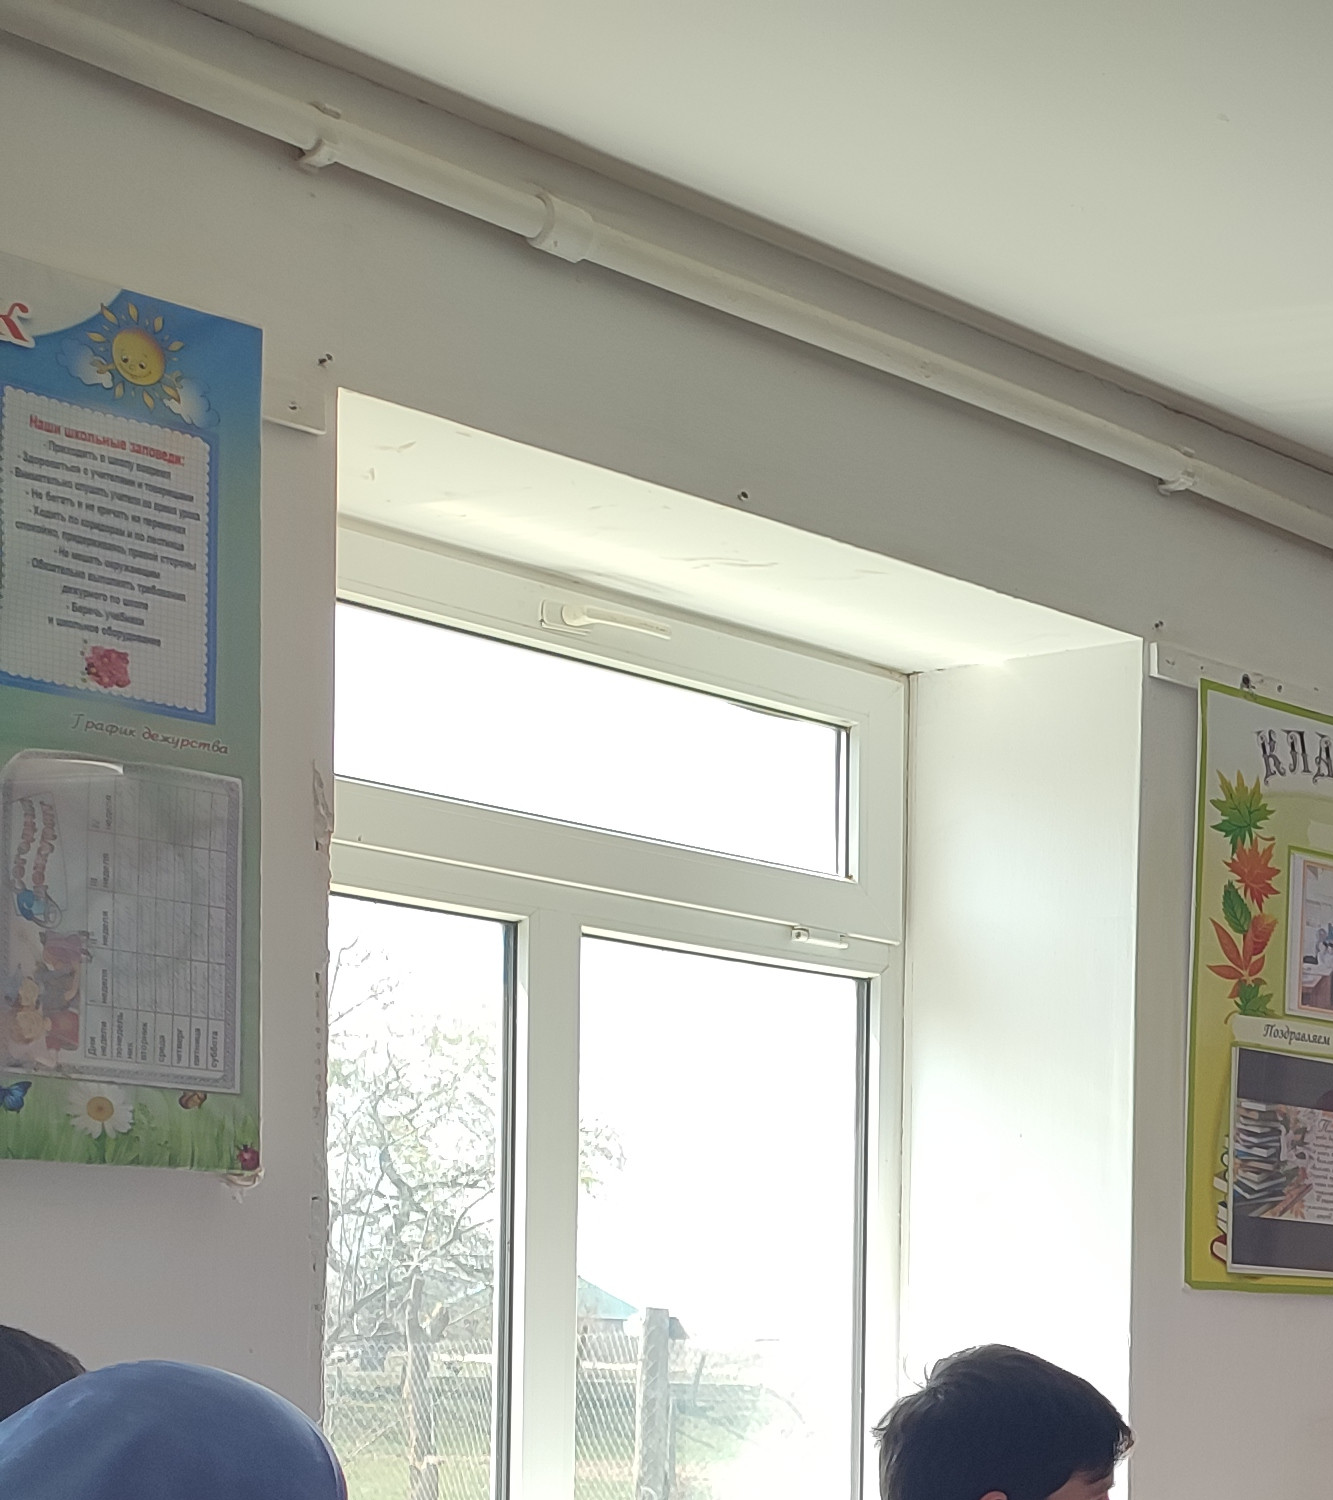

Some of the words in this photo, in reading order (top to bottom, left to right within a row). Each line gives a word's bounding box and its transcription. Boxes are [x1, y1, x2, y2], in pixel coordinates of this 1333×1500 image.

[29, 414, 61, 435] Наши
[64, 426, 127, 451] школьные
[72, 713, 137, 737] График
[142, 726, 229, 755] дежурства
[1263, 1023, 1331, 1046] Поздравляем
